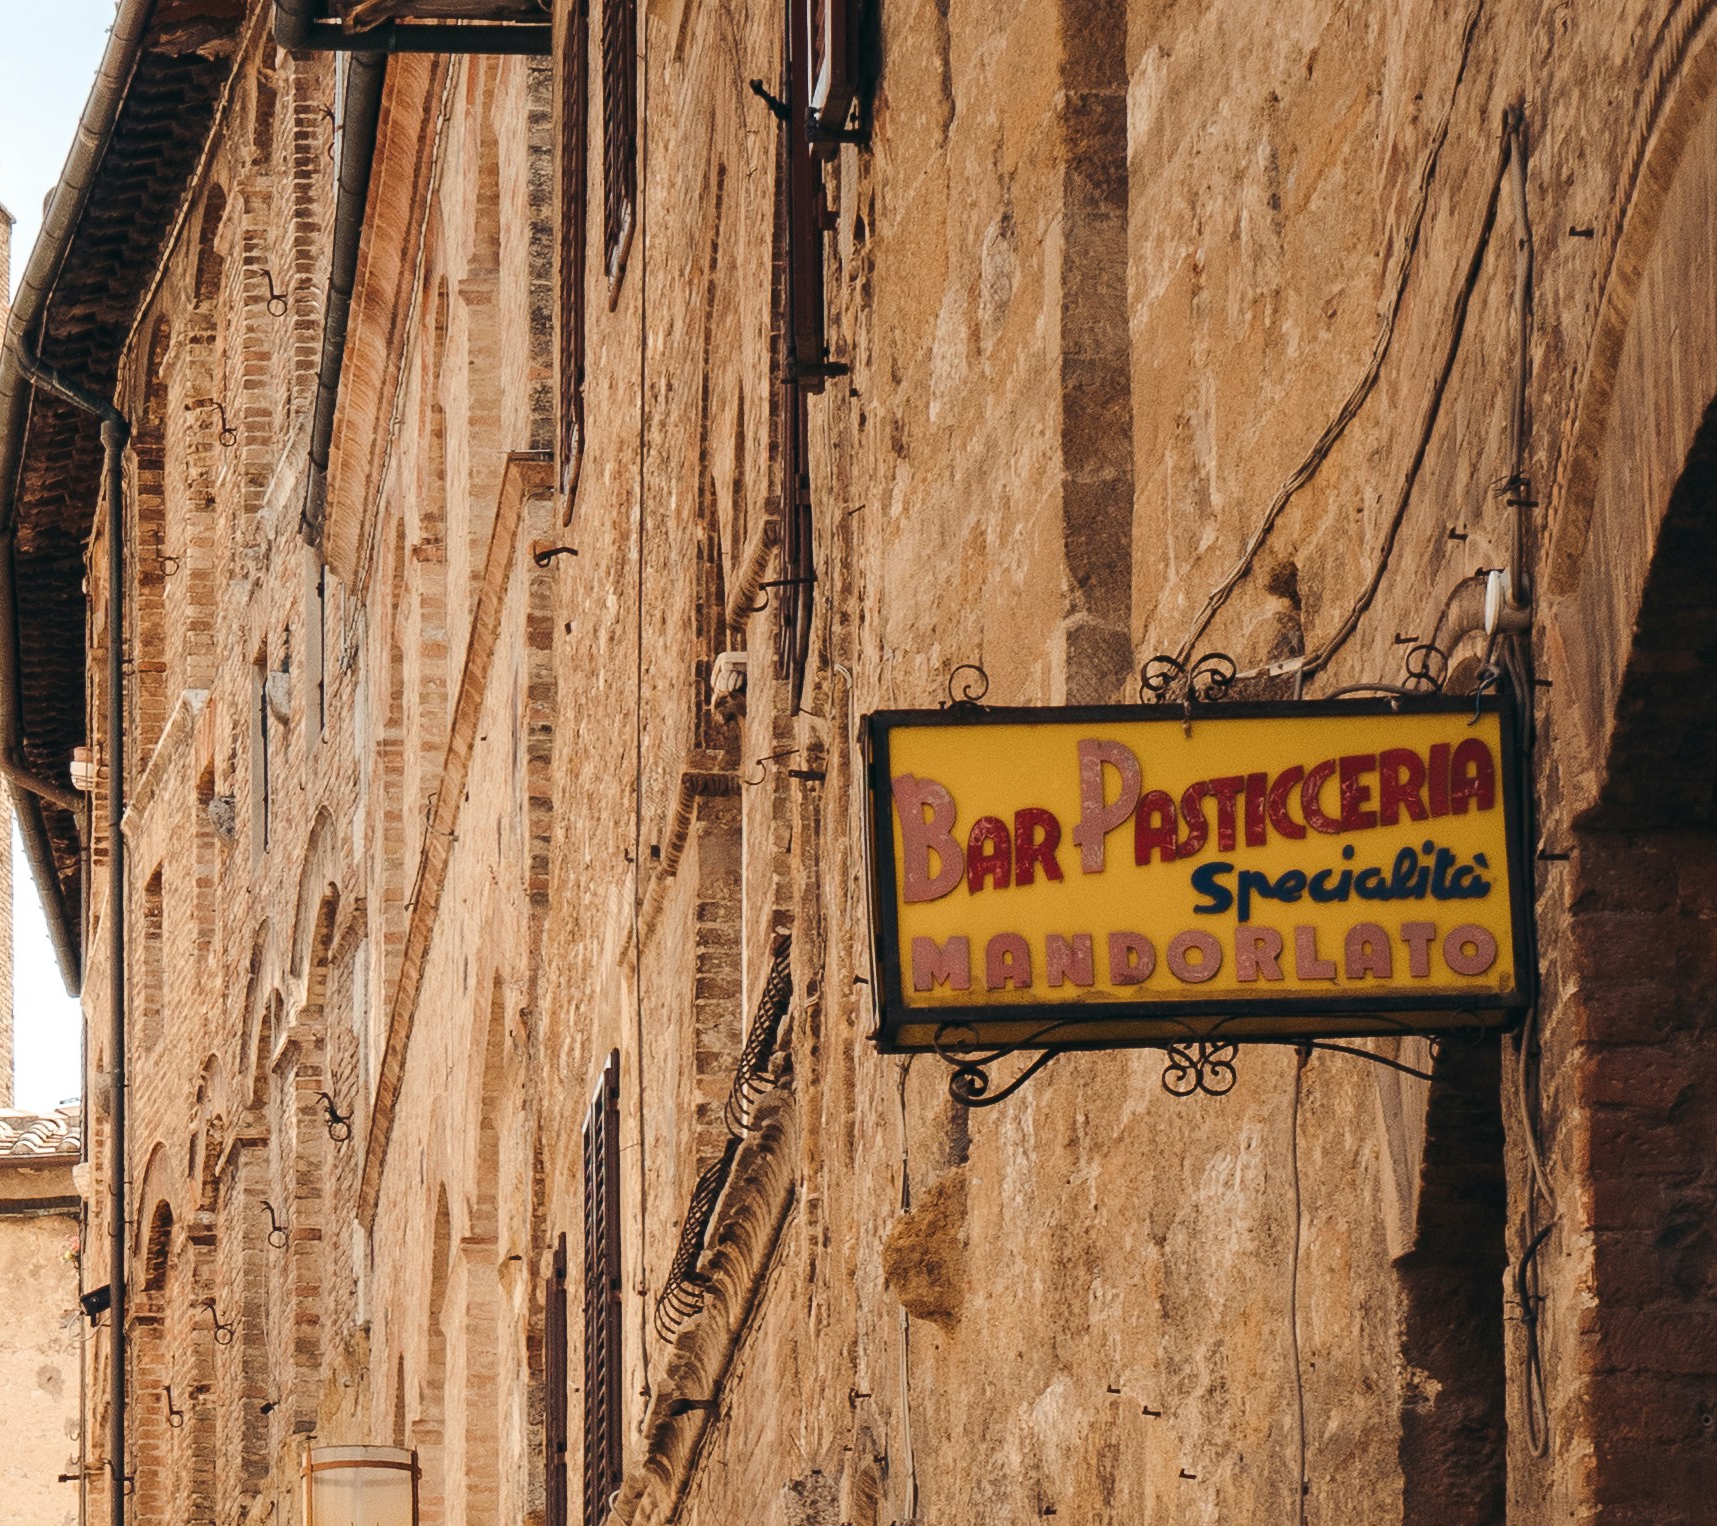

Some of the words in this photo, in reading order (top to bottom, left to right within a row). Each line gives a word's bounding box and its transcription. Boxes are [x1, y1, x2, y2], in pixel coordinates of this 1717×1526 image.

[892, 772, 1063, 903] BAR
[1073, 738, 1495, 875] PASTICCERIA
[1191, 839, 1492, 922] Specialità
[911, 922, 1497, 992] MANDORLATO
